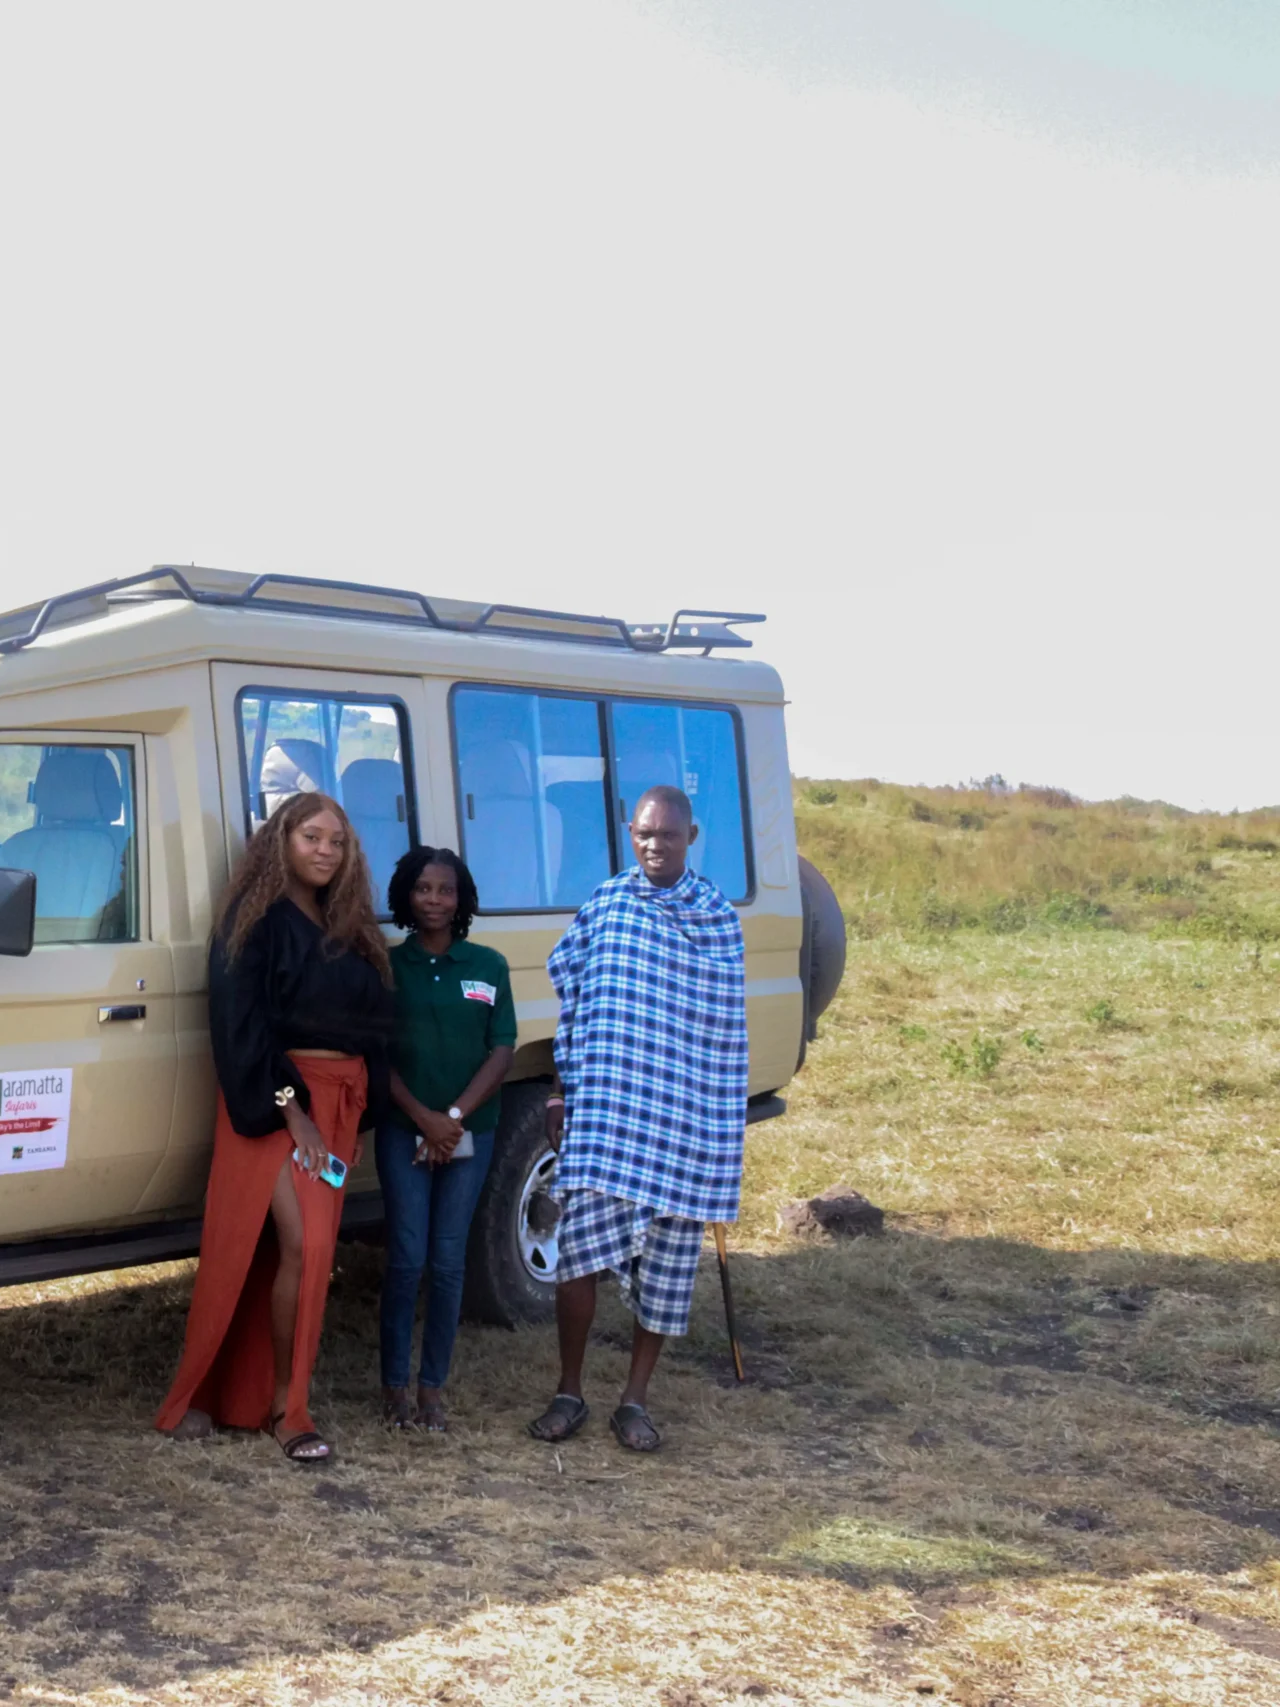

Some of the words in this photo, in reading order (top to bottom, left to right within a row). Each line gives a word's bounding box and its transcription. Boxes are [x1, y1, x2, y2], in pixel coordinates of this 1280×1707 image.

[5, 1100, 37, 1115] Safaris
[13, 1121, 24, 1130] the
[24, 1119, 41, 1129] Limit
